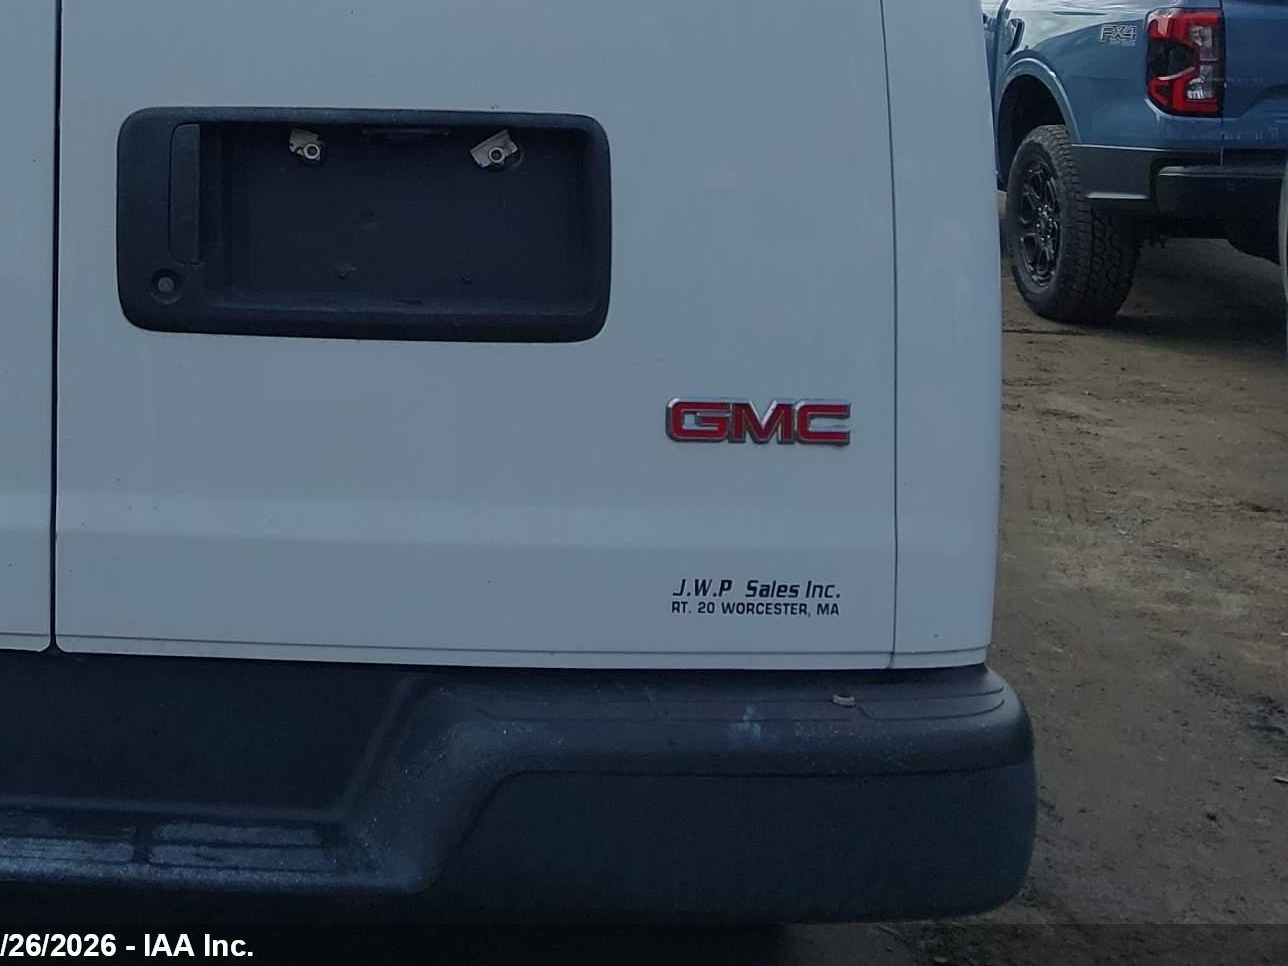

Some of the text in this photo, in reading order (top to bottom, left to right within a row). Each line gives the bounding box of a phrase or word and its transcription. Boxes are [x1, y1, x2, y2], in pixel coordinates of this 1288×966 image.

[1099, 24, 1137, 42] FX4
[665, 396, 851, 446] GMC
[672, 578, 841, 599] J.W.P Sales Inc.
[671, 601, 840, 617] RT. 20 WORCESTER, MA
